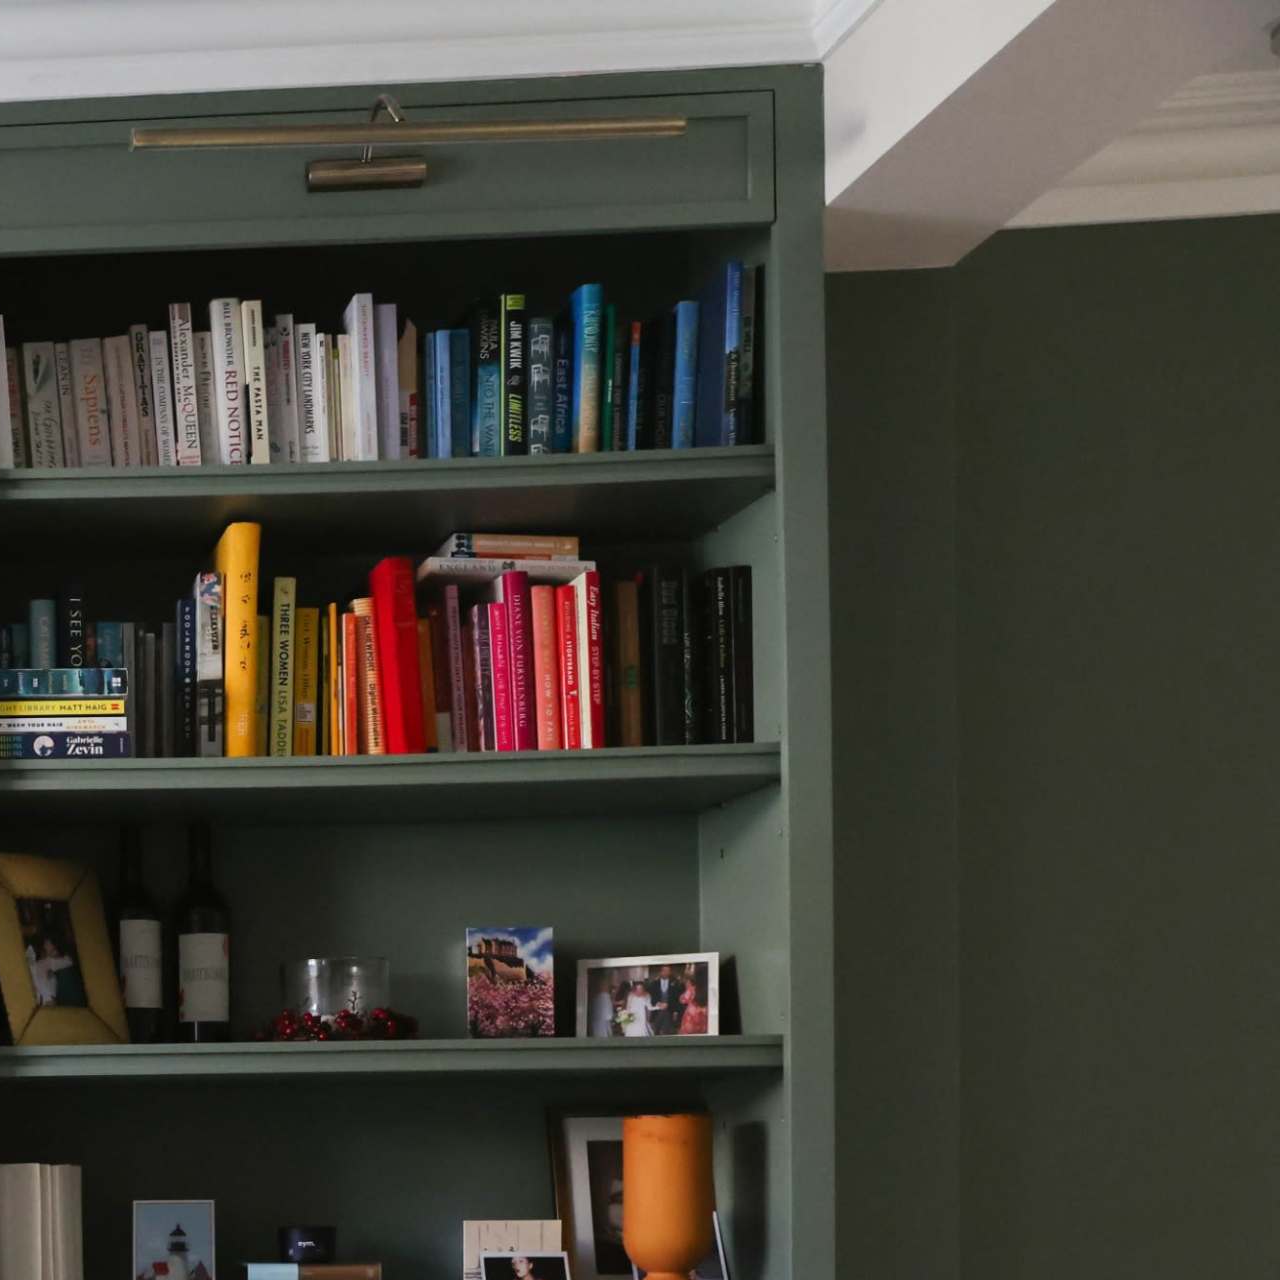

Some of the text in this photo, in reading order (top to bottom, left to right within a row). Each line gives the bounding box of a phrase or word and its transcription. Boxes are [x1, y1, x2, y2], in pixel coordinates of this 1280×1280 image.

[223, 302, 232, 319] BILL
[224, 321, 235, 367] BROWDER
[488, 319, 498, 351] PAULA
[61, 384, 70, 396] IN
[134, 332, 150, 418] GRAVITAS
[177, 320, 198, 449] Alexander McQUEEN
[225, 370, 240, 402] RED
[301, 333, 315, 435] NEW YORK CITY LANDMARKS
[508, 321, 522, 442] JIM KWIK LIMITLESS
[81, 375, 102, 449] Sapiens
[155, 357, 171, 466] IN THE COMPANY OF WOME
[253, 366, 264, 441] THE PASTA MAN
[484, 402, 495, 421] THE
[555, 358, 569, 434] East Africa
[68, 608, 82, 637] SEE
[661, 608, 678, 645] Blood
[68, 643, 83, 668] YO
[365, 634, 375, 672] NEWPORT
[513, 594, 528, 728] DIANE VON FURSTENBERG
[566, 641, 575, 686] STORYBRAND
[587, 586, 601, 705] Easy Italian STEP-BY-STEP
[276, 603, 291, 758] THREE WOMEN LISA TADDE
[368, 683, 377, 706] Digital
[46, 720, 64, 728] HAIR
[59, 703, 83, 711] MATT
[85, 702, 107, 711] HAIG
[543, 673, 555, 742] HOW TO FAIL
[65, 743, 105, 755] Zevin
[66, 735, 105, 744] Gabrielle
